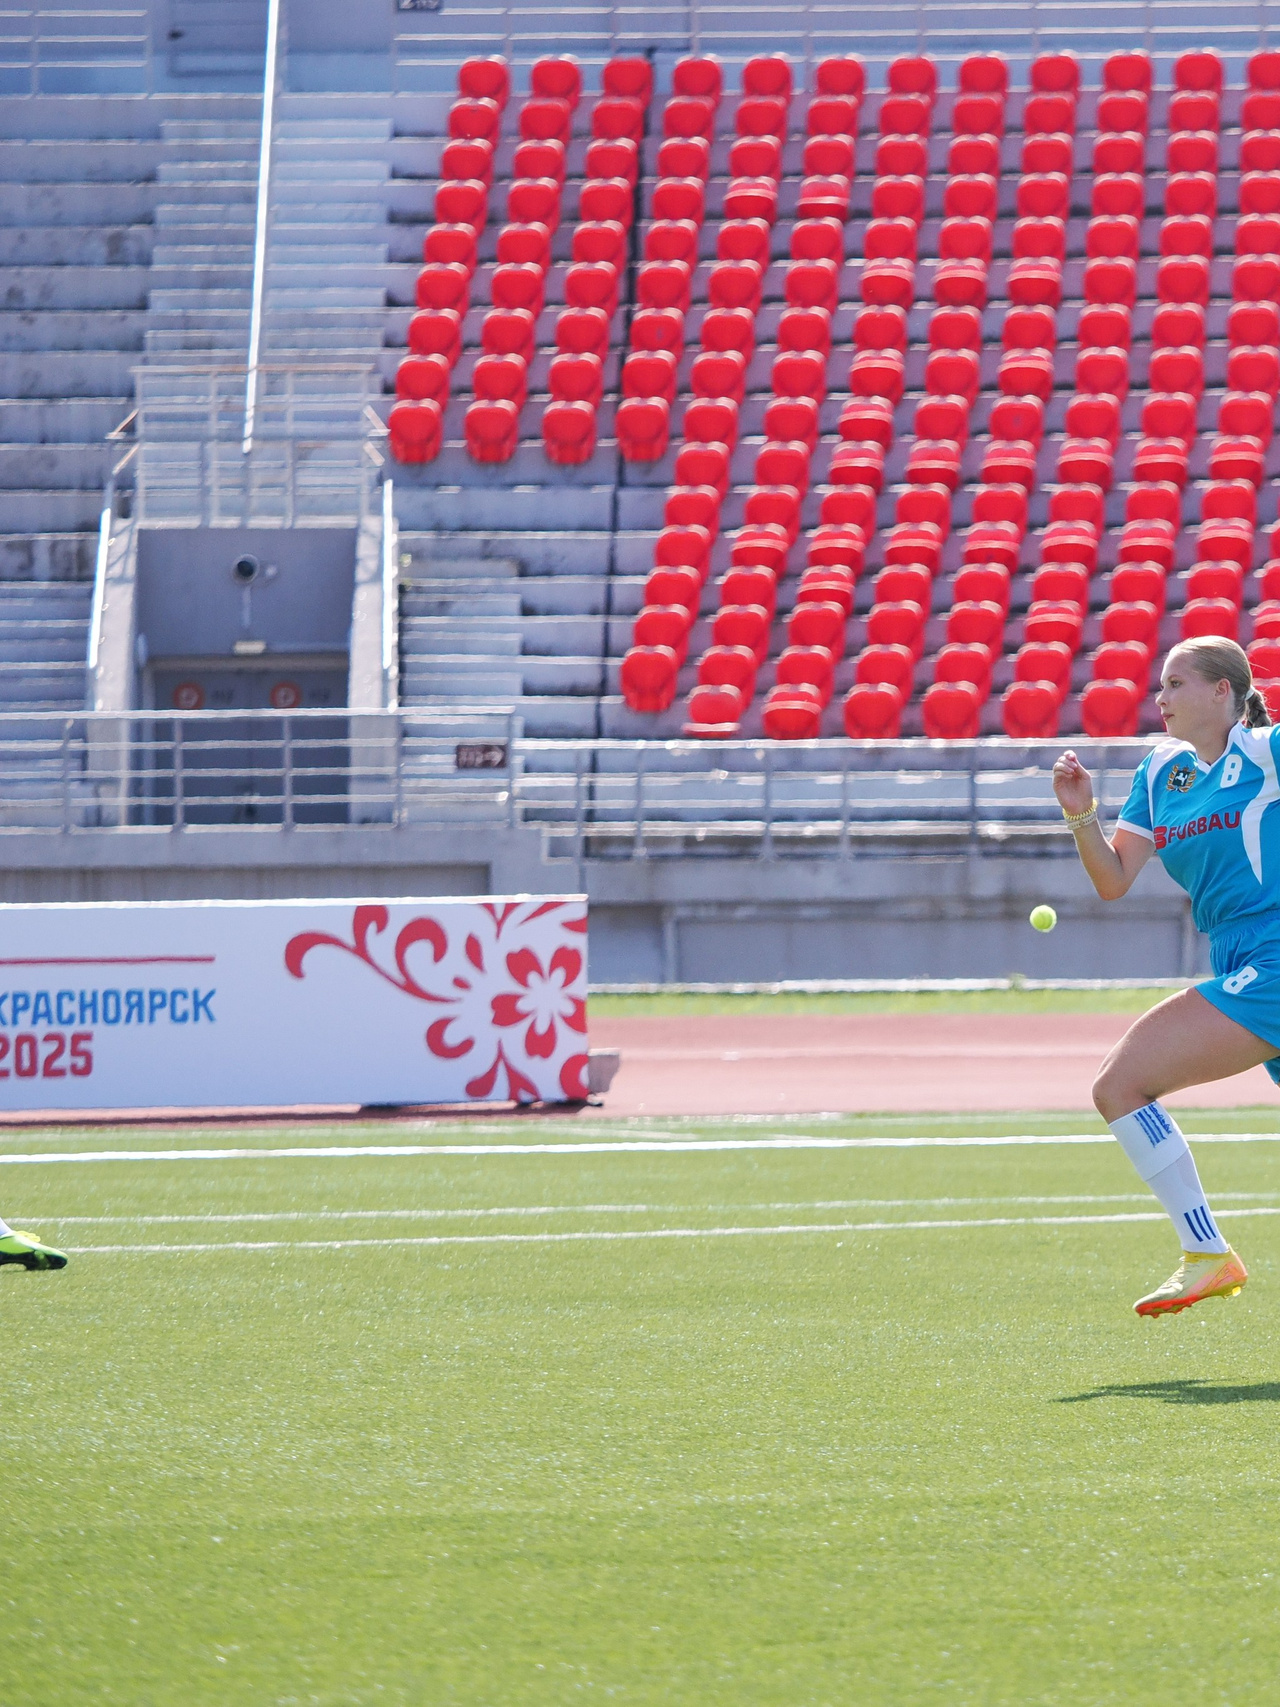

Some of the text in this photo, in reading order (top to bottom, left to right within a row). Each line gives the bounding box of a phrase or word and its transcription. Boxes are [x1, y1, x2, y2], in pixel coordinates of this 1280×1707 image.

[1219, 754, 1243, 788] 8
[1168, 810, 1241, 843] FURBAU
[1222, 966, 1258, 994] 8
